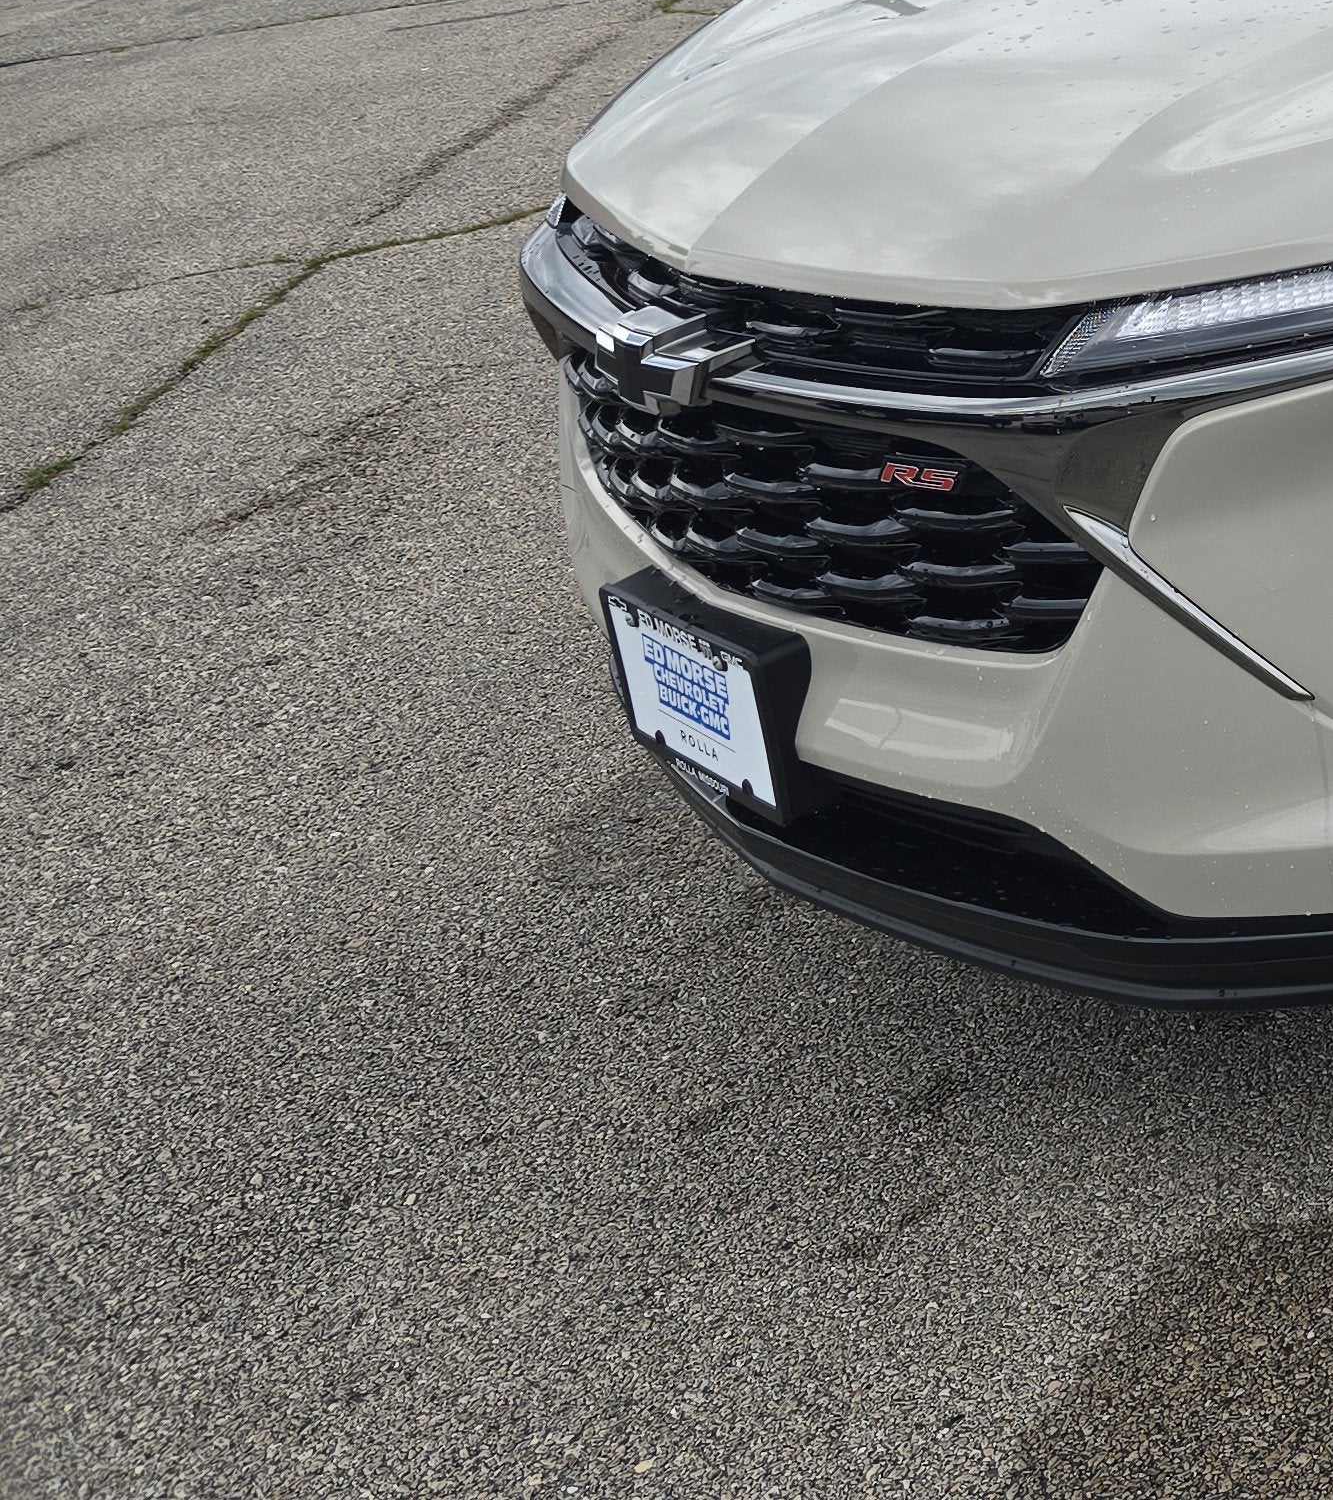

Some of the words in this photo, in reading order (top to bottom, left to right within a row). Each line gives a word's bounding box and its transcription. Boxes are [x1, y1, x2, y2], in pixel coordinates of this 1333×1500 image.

[881, 462, 959, 492] RS
[637, 608, 654, 630] ED
[653, 616, 698, 650] MORSE
[642, 633, 667, 668] ED
[664, 645, 729, 701] MORSE
[679, 729, 719, 762] ROLLA
[675, 757, 699, 780] ROLLA
